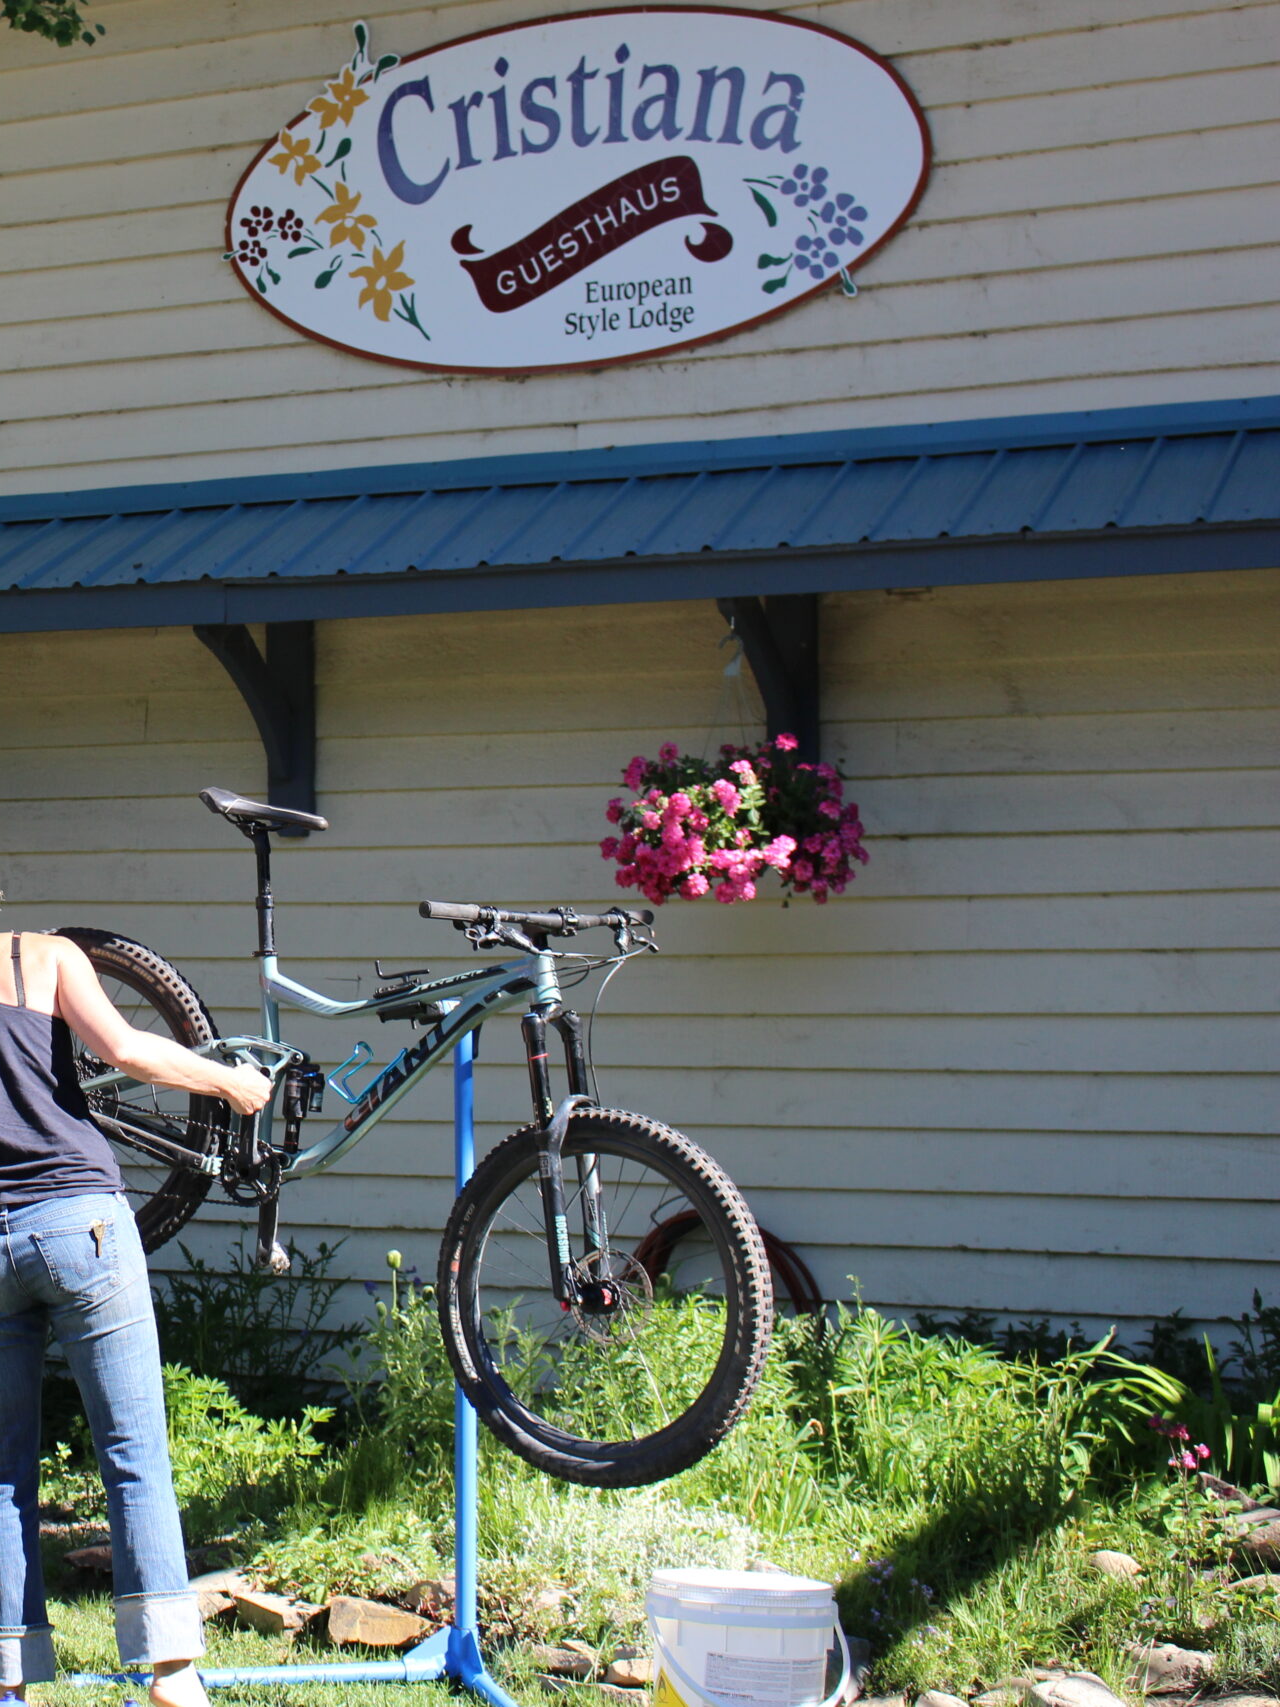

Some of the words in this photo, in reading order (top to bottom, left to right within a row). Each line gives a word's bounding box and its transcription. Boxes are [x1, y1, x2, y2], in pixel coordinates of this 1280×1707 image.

[377, 42, 805, 206] Cristiana
[496, 176, 681, 294] GUESTHAUS
[564, 311, 620, 340] Style
[628, 302, 695, 333] Lodge
[585, 275, 692, 304] European
